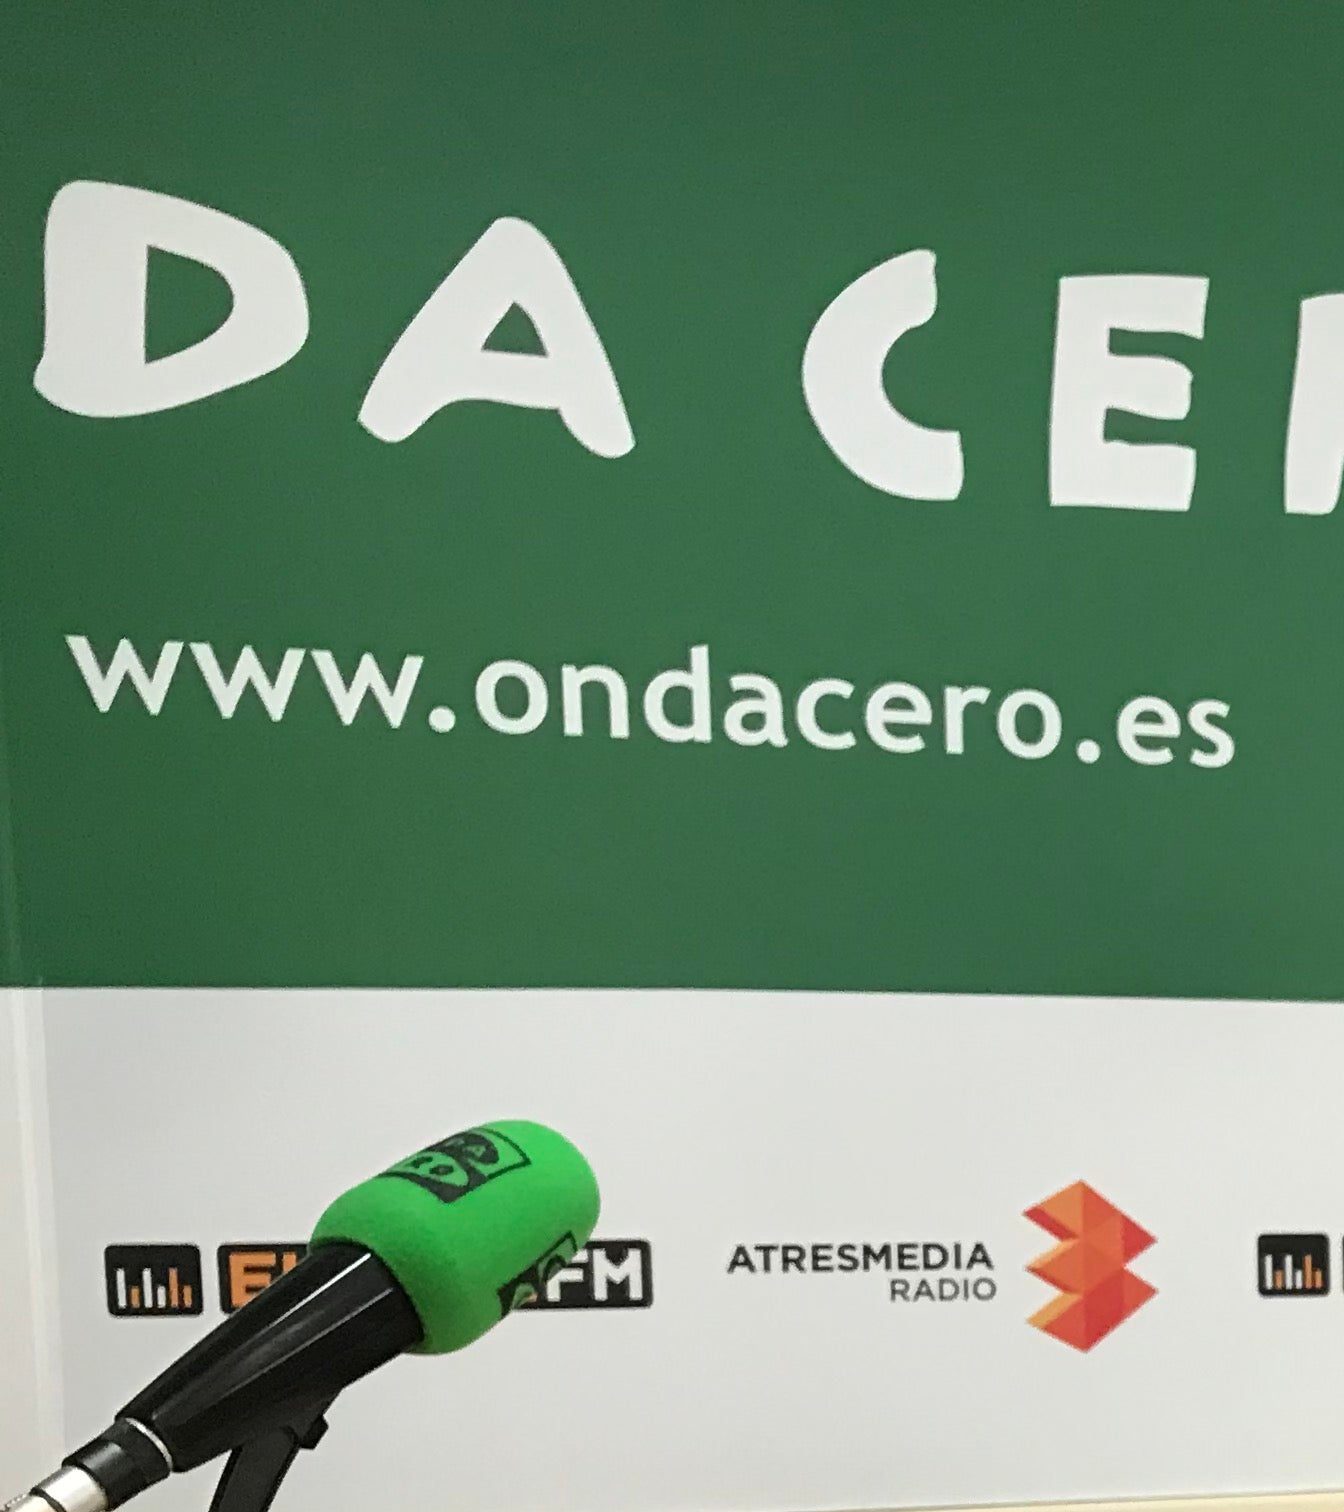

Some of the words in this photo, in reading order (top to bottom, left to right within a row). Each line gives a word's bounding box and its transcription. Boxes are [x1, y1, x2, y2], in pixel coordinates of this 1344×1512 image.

[34, 180, 636, 459] DA
[66, 634, 1236, 768] www.ondacero.es
[727, 1242, 995, 1275] ATRESMEDIA
[889, 1277, 997, 1303] RADIO
